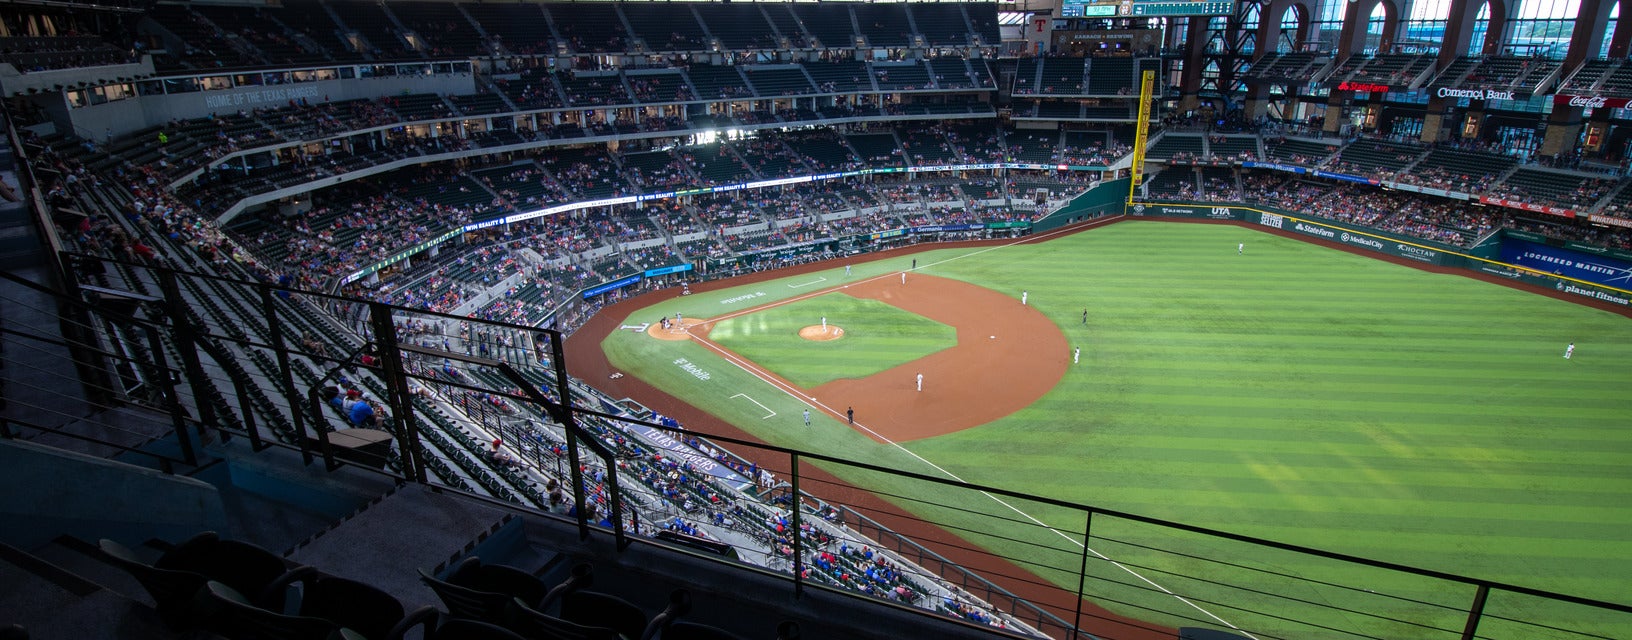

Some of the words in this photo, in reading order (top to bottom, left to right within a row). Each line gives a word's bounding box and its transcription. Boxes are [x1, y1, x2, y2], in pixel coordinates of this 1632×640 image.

[1034, 19, 1046, 33] T
[206, 95, 232, 108] HOME
[233, 93, 244, 105] OF
[245, 91, 260, 103] THE
[261, 89, 286, 101] TEXAS
[287, 86, 319, 99] RANGERS
[1486, 89, 1515, 101] Bank
[1211, 207, 1231, 216] UTA
[465, 223, 478, 231] WIN
[478, 219, 499, 229] REALITY
[1260, 216, 1283, 229] SELTZER
[1401, 244, 1437, 258] CHOCTAW
[1524, 251, 1573, 267] LOCKHEED
[1575, 262, 1615, 276] MARTIN
[1564, 285, 1596, 298] planet
[1596, 291, 1629, 305] fitness
[643, 428, 676, 447] TEXAS
[671, 443, 718, 471] RANGERS
